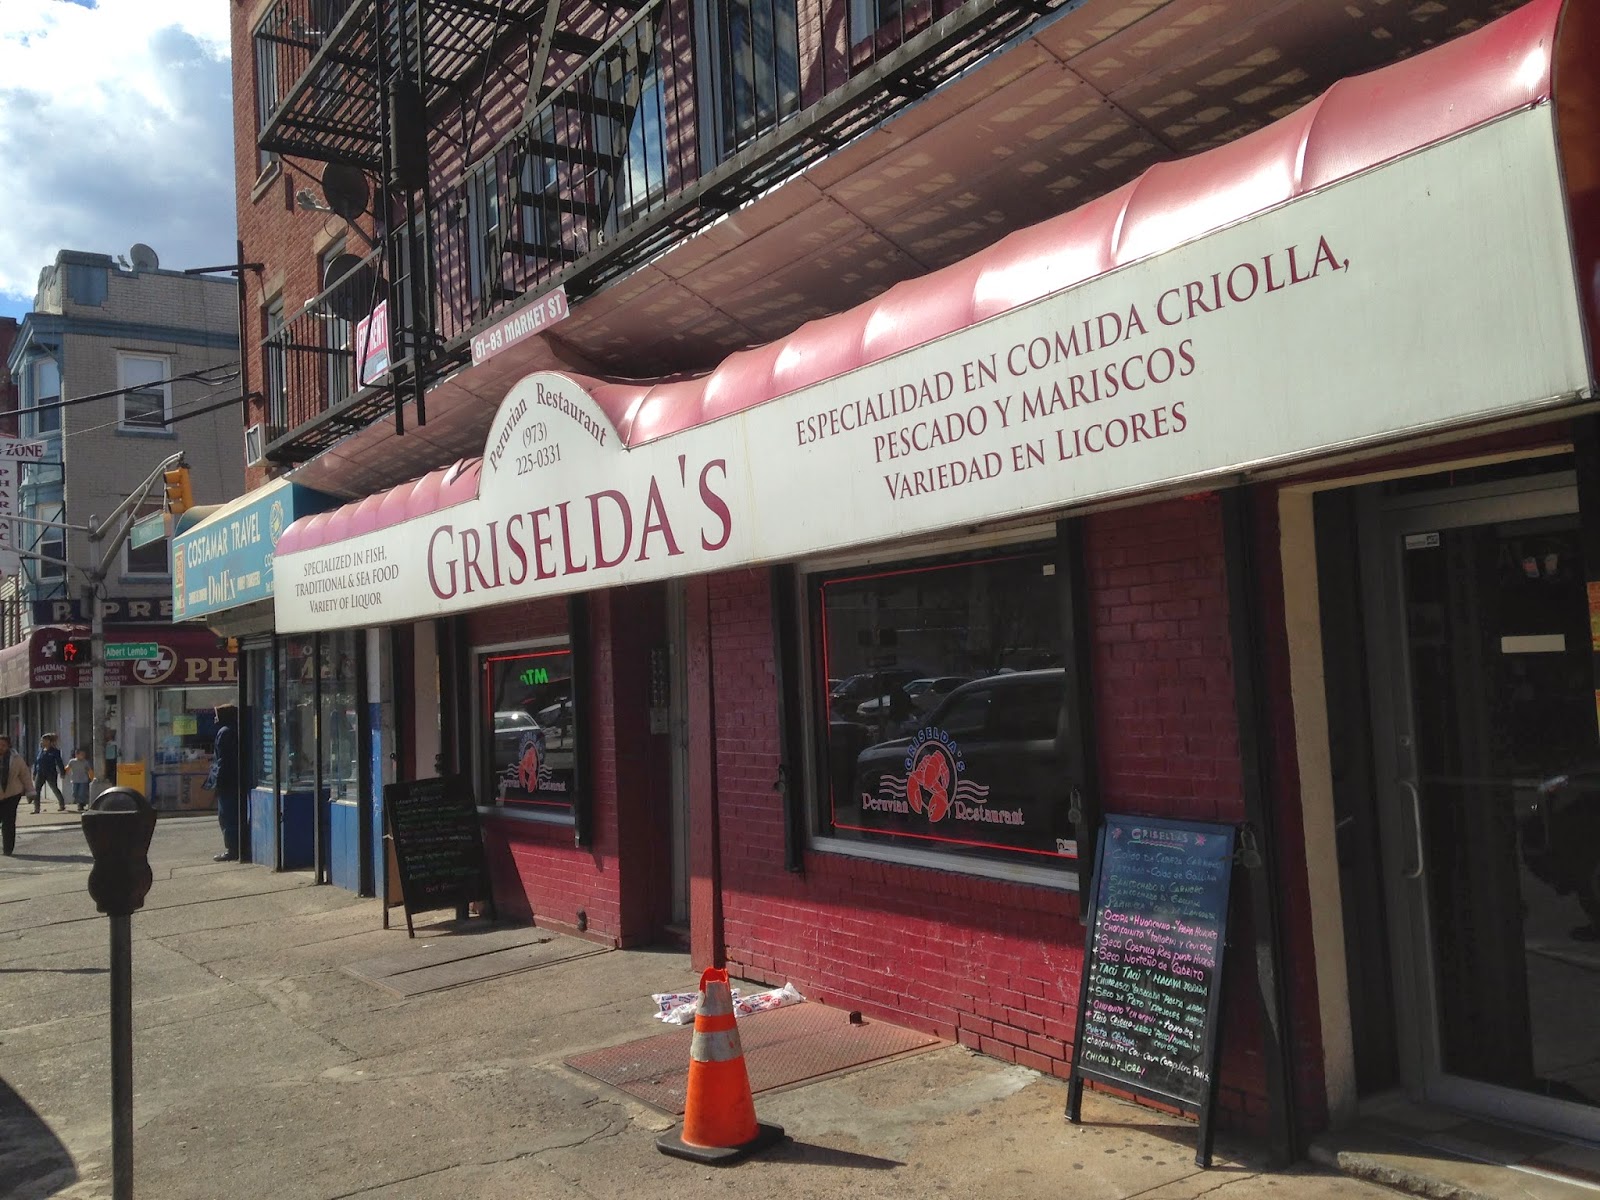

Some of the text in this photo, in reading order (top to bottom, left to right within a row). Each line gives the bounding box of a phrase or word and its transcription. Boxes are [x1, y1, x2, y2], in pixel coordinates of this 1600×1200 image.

[475, 294, 562, 359] 81-83 MARKET ST
[796, 234, 1350, 447] ESPECIALIDAD EN COMIDA CRIOLLA,
[874, 338, 1197, 463] PESCADO Y MARISCOS
[489, 382, 607, 473] Peruvian Restaurant
[522, 421, 548, 449] (973)
[6, 443, 43, 457] ZONE
[515, 443, 562, 476] 225-0331
[884, 402, 1188, 501] VARIEDAD EN LICORES
[188, 527, 228, 568] COSTAMAR
[231, 511, 260, 551] TRAVEL
[427, 454, 732, 600] GRISELDA'S
[295, 564, 399, 597] TRADITIONAL & SEA FOOD
[304, 546, 387, 576] SPECIALIZED IN FISH,
[310, 592, 382, 613] VARIETY OF LIQUOR
[33, 664, 67, 675] PHARMACY
[904, 726, 966, 772] GRISELDA'S
[862, 792, 1025, 826] Peruvian Restaurant
